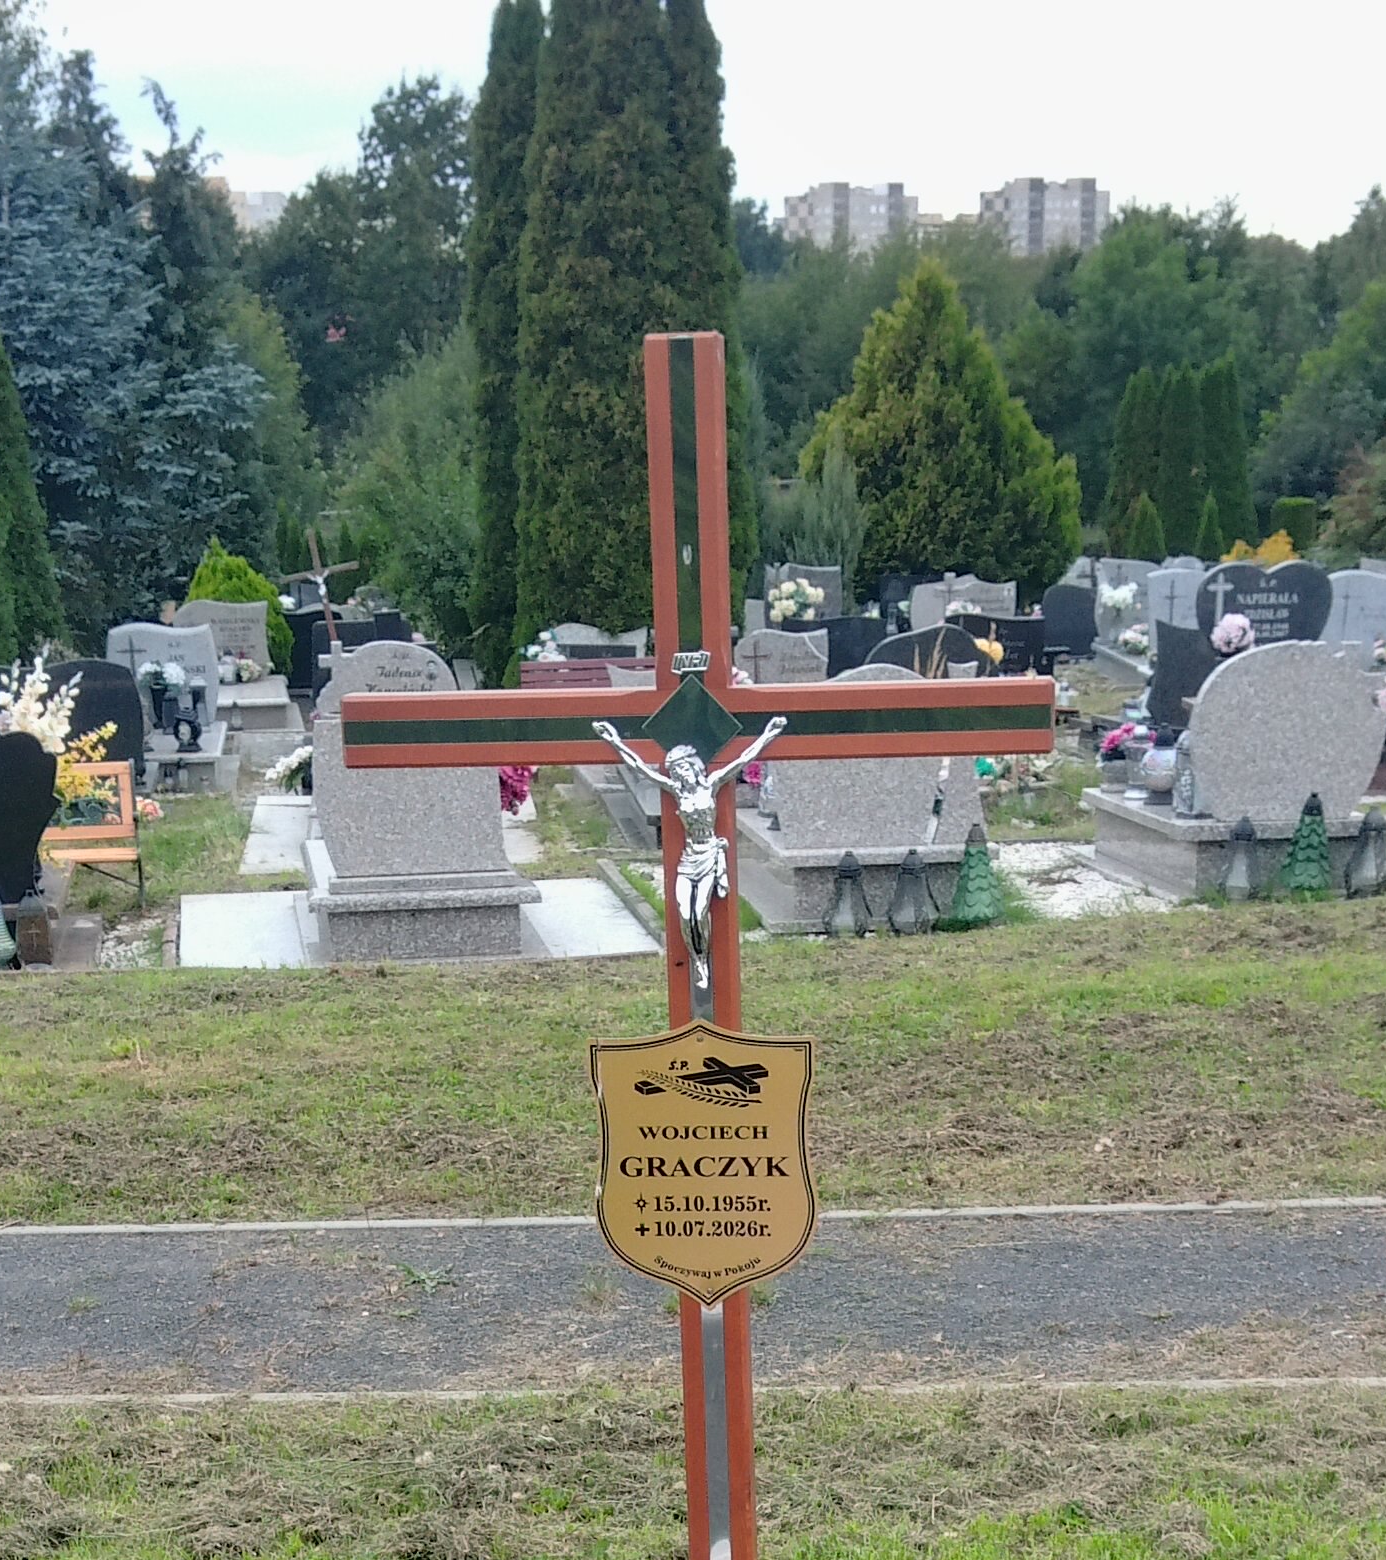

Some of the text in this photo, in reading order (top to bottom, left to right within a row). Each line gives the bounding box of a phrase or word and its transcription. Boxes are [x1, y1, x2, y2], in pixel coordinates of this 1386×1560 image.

[638, 1125, 770, 1140] WOJCIECH
[619, 1155, 790, 1178] GRACZYK
[653, 1195, 772, 1212] 15.10.1955r.
[654, 1220, 772, 1237] 10.07.2026r.
[653, 1255, 762, 1280] Spoczywaj w Pokoju
